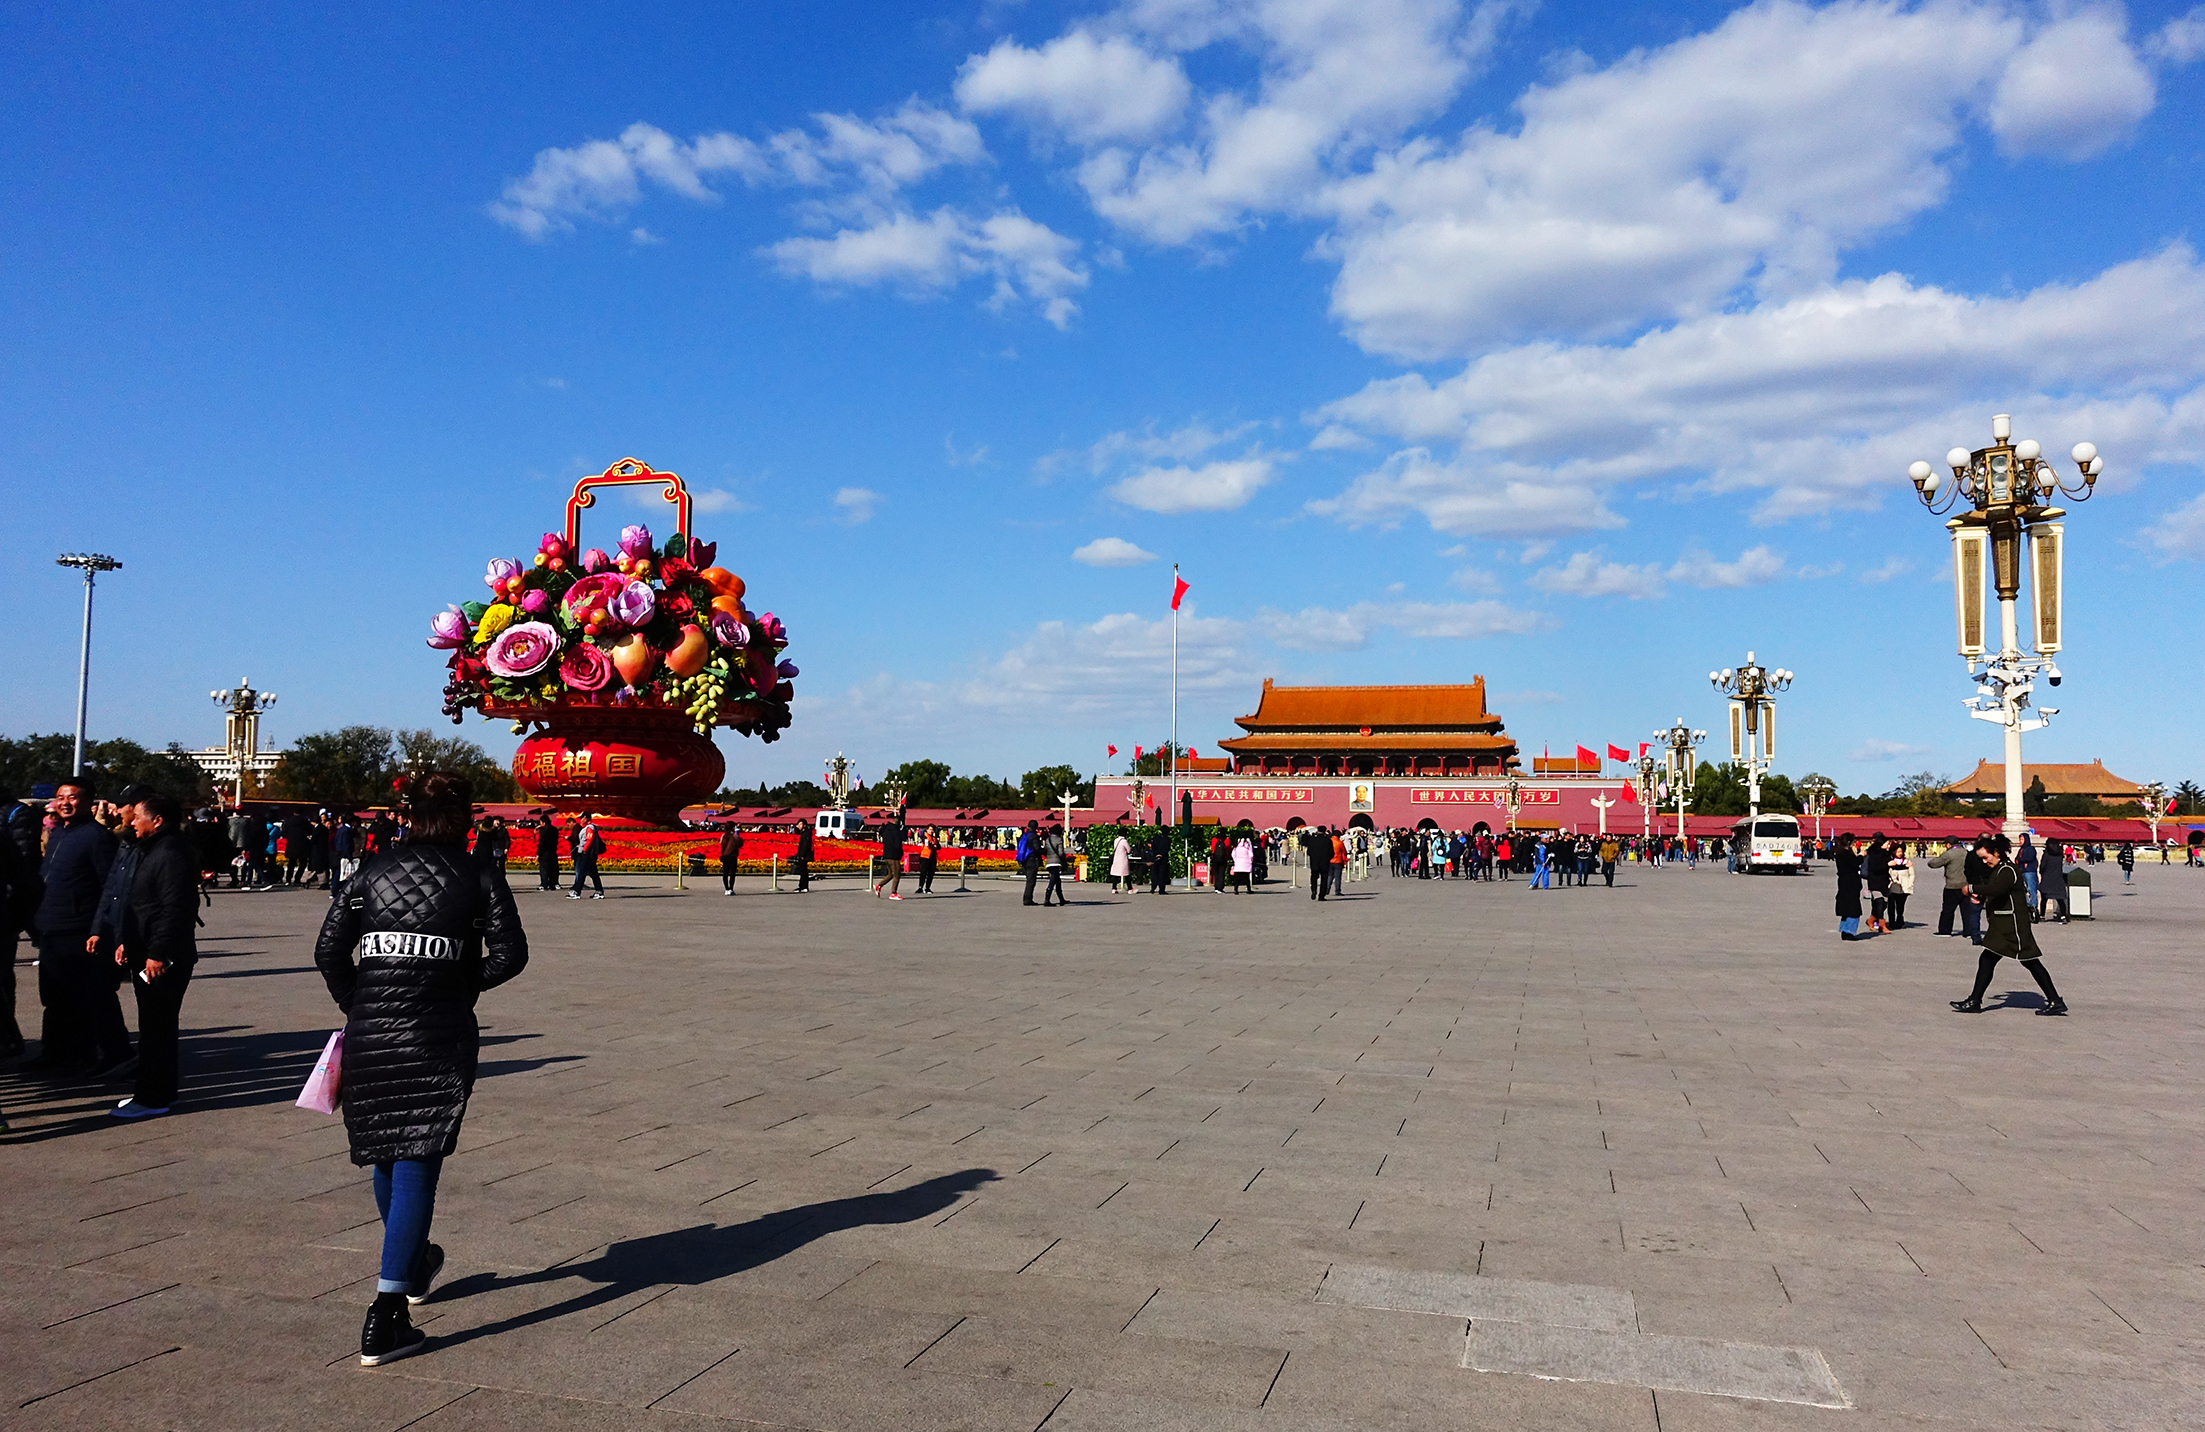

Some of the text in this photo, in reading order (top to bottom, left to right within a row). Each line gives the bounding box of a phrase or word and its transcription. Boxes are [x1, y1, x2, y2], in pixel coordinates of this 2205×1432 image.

[512, 751, 642, 778] 祝福祖国
[1184, 789, 1306, 800] 华人民共和国万岁
[1419, 791, 1551, 802] 世界人民大团万岁
[361, 932, 465, 960] FASHION
